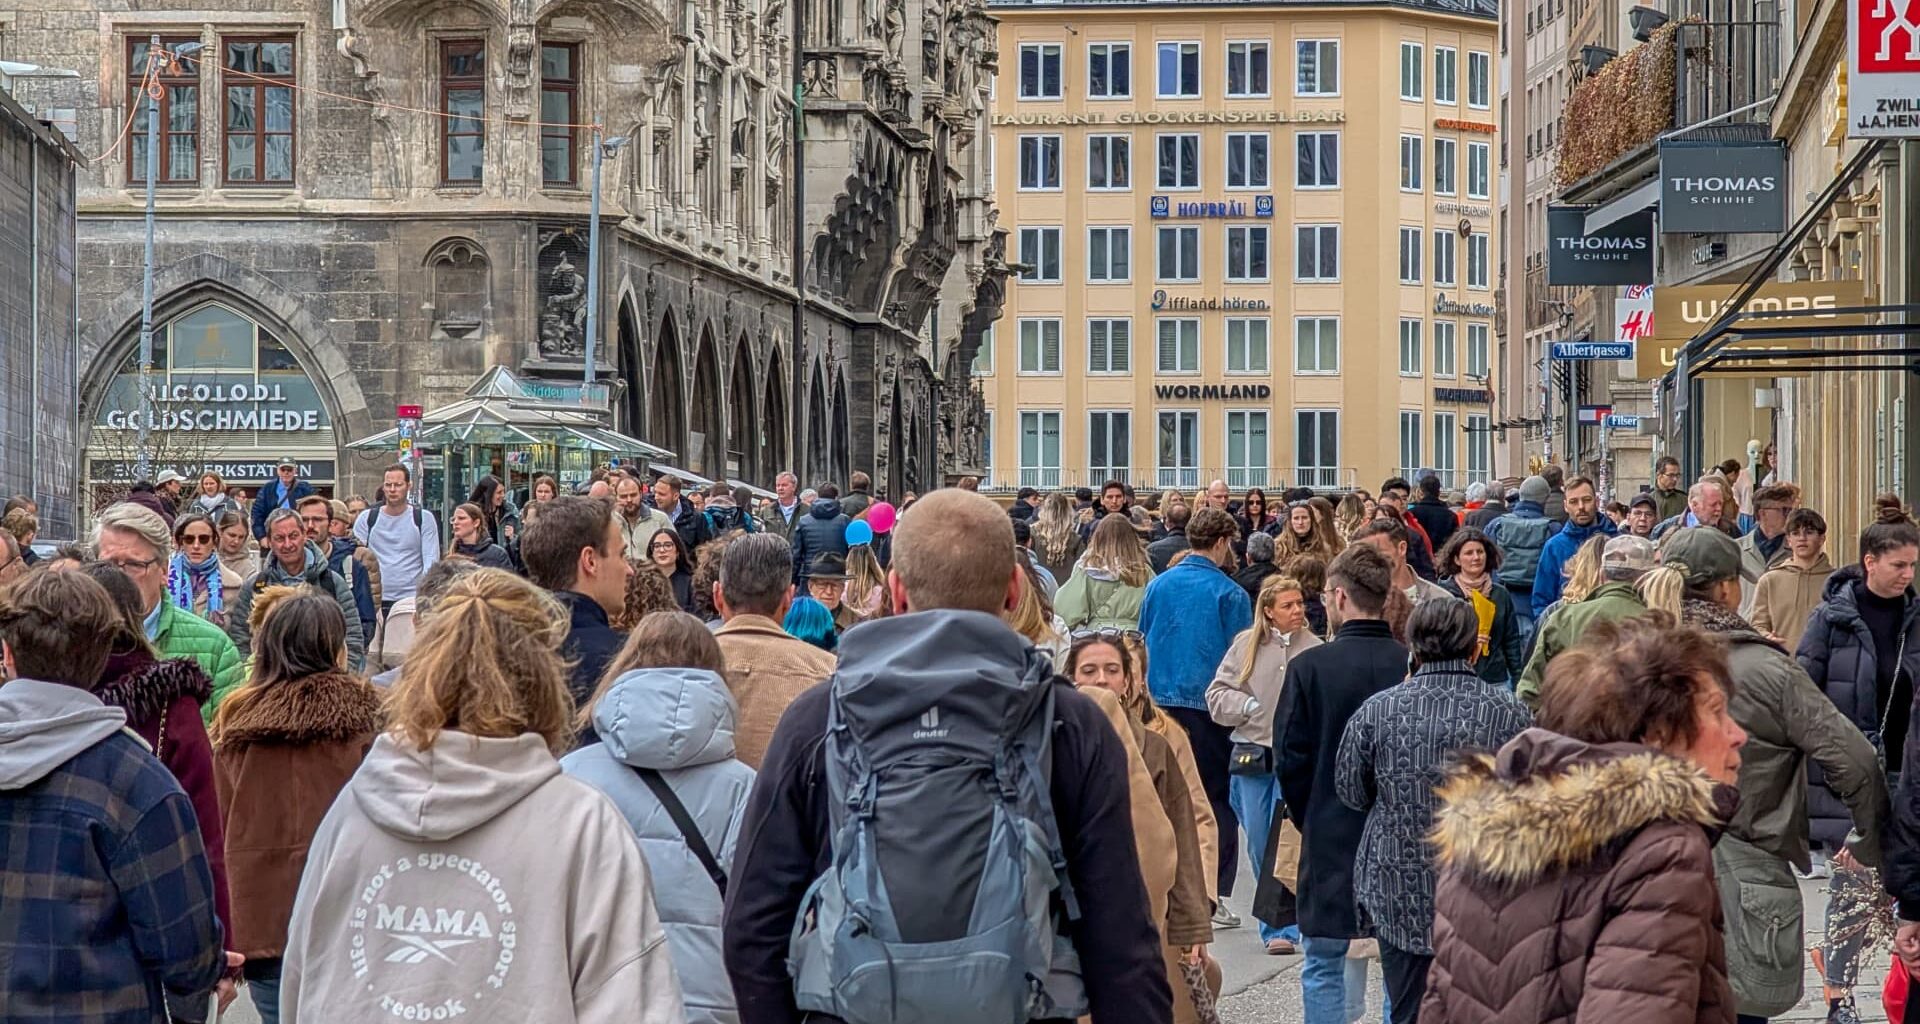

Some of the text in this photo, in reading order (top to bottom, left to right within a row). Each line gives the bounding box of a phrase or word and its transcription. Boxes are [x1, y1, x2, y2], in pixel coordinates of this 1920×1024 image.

[1116, 112, 1288, 124] GLOCKENSPIEL
[1299, 111, 1346, 122] BAR
[1857, 114, 1920, 129] J.A.HEN
[1670, 177, 1775, 191] THOMAS
[1690, 196, 1755, 204] SCHUHE
[1178, 200, 1247, 217] HOFBRÄU
[1556, 237, 1647, 250] THOMAS
[1573, 253, 1630, 261] SCHUHE
[1559, 341, 1626, 359] Albertgasse
[1155, 385, 1271, 399] WORMLAND
[107, 410, 319, 431] GOLDSCHMIEDE
[1612, 415, 1639, 426] Filser
[184, 463, 312, 478] WERKSTÄTEN
[913, 730, 949, 739] deuter
[350, 852, 516, 989] life is not a spectator sport
[375, 903, 493, 939] MAMA
[381, 995, 467, 1021] reebok
